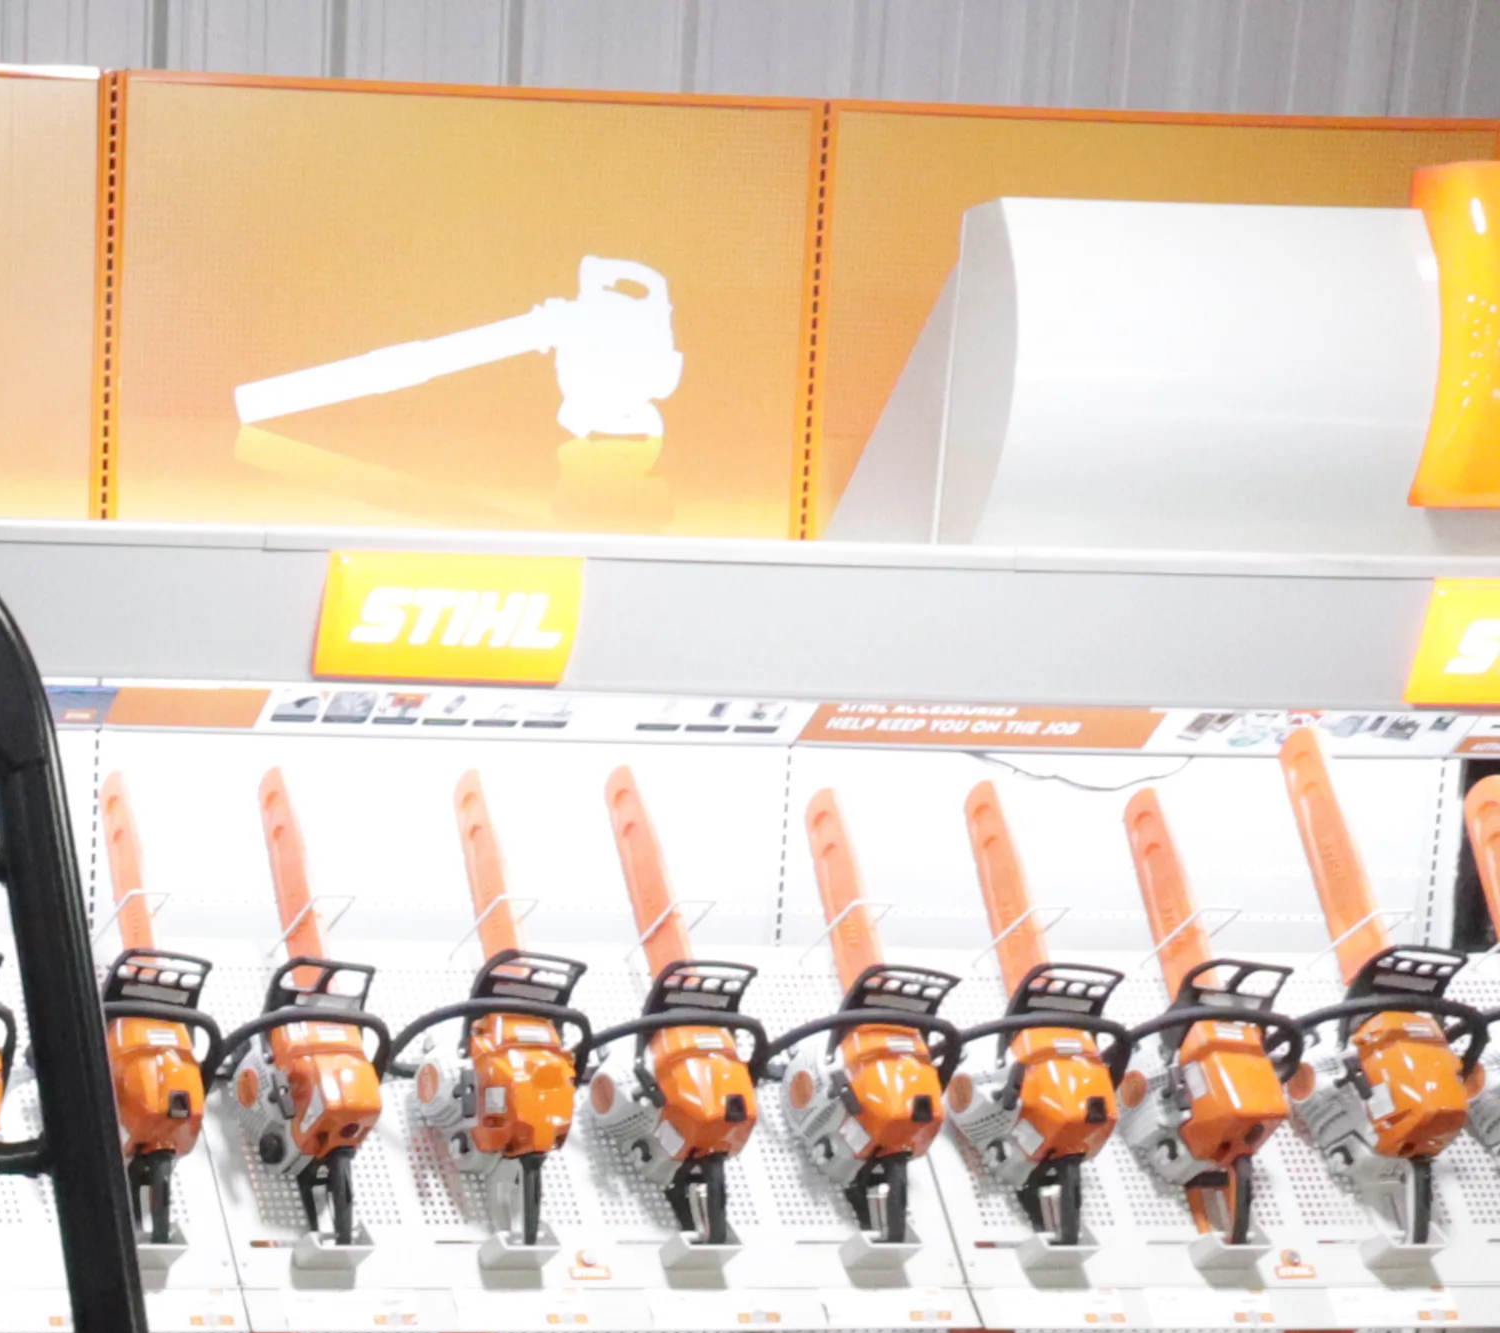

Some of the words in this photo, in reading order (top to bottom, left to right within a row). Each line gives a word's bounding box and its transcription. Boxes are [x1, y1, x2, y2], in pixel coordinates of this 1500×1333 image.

[350, 587, 564, 650] STIHL
[825, 716, 878, 731] HELP
[875, 717, 927, 732] KEEP
[928, 719, 971, 733] YOU
[970, 720, 1003, 734] ON
[1003, 721, 1043, 735] THE
[1041, 721, 1082, 736] JOB
